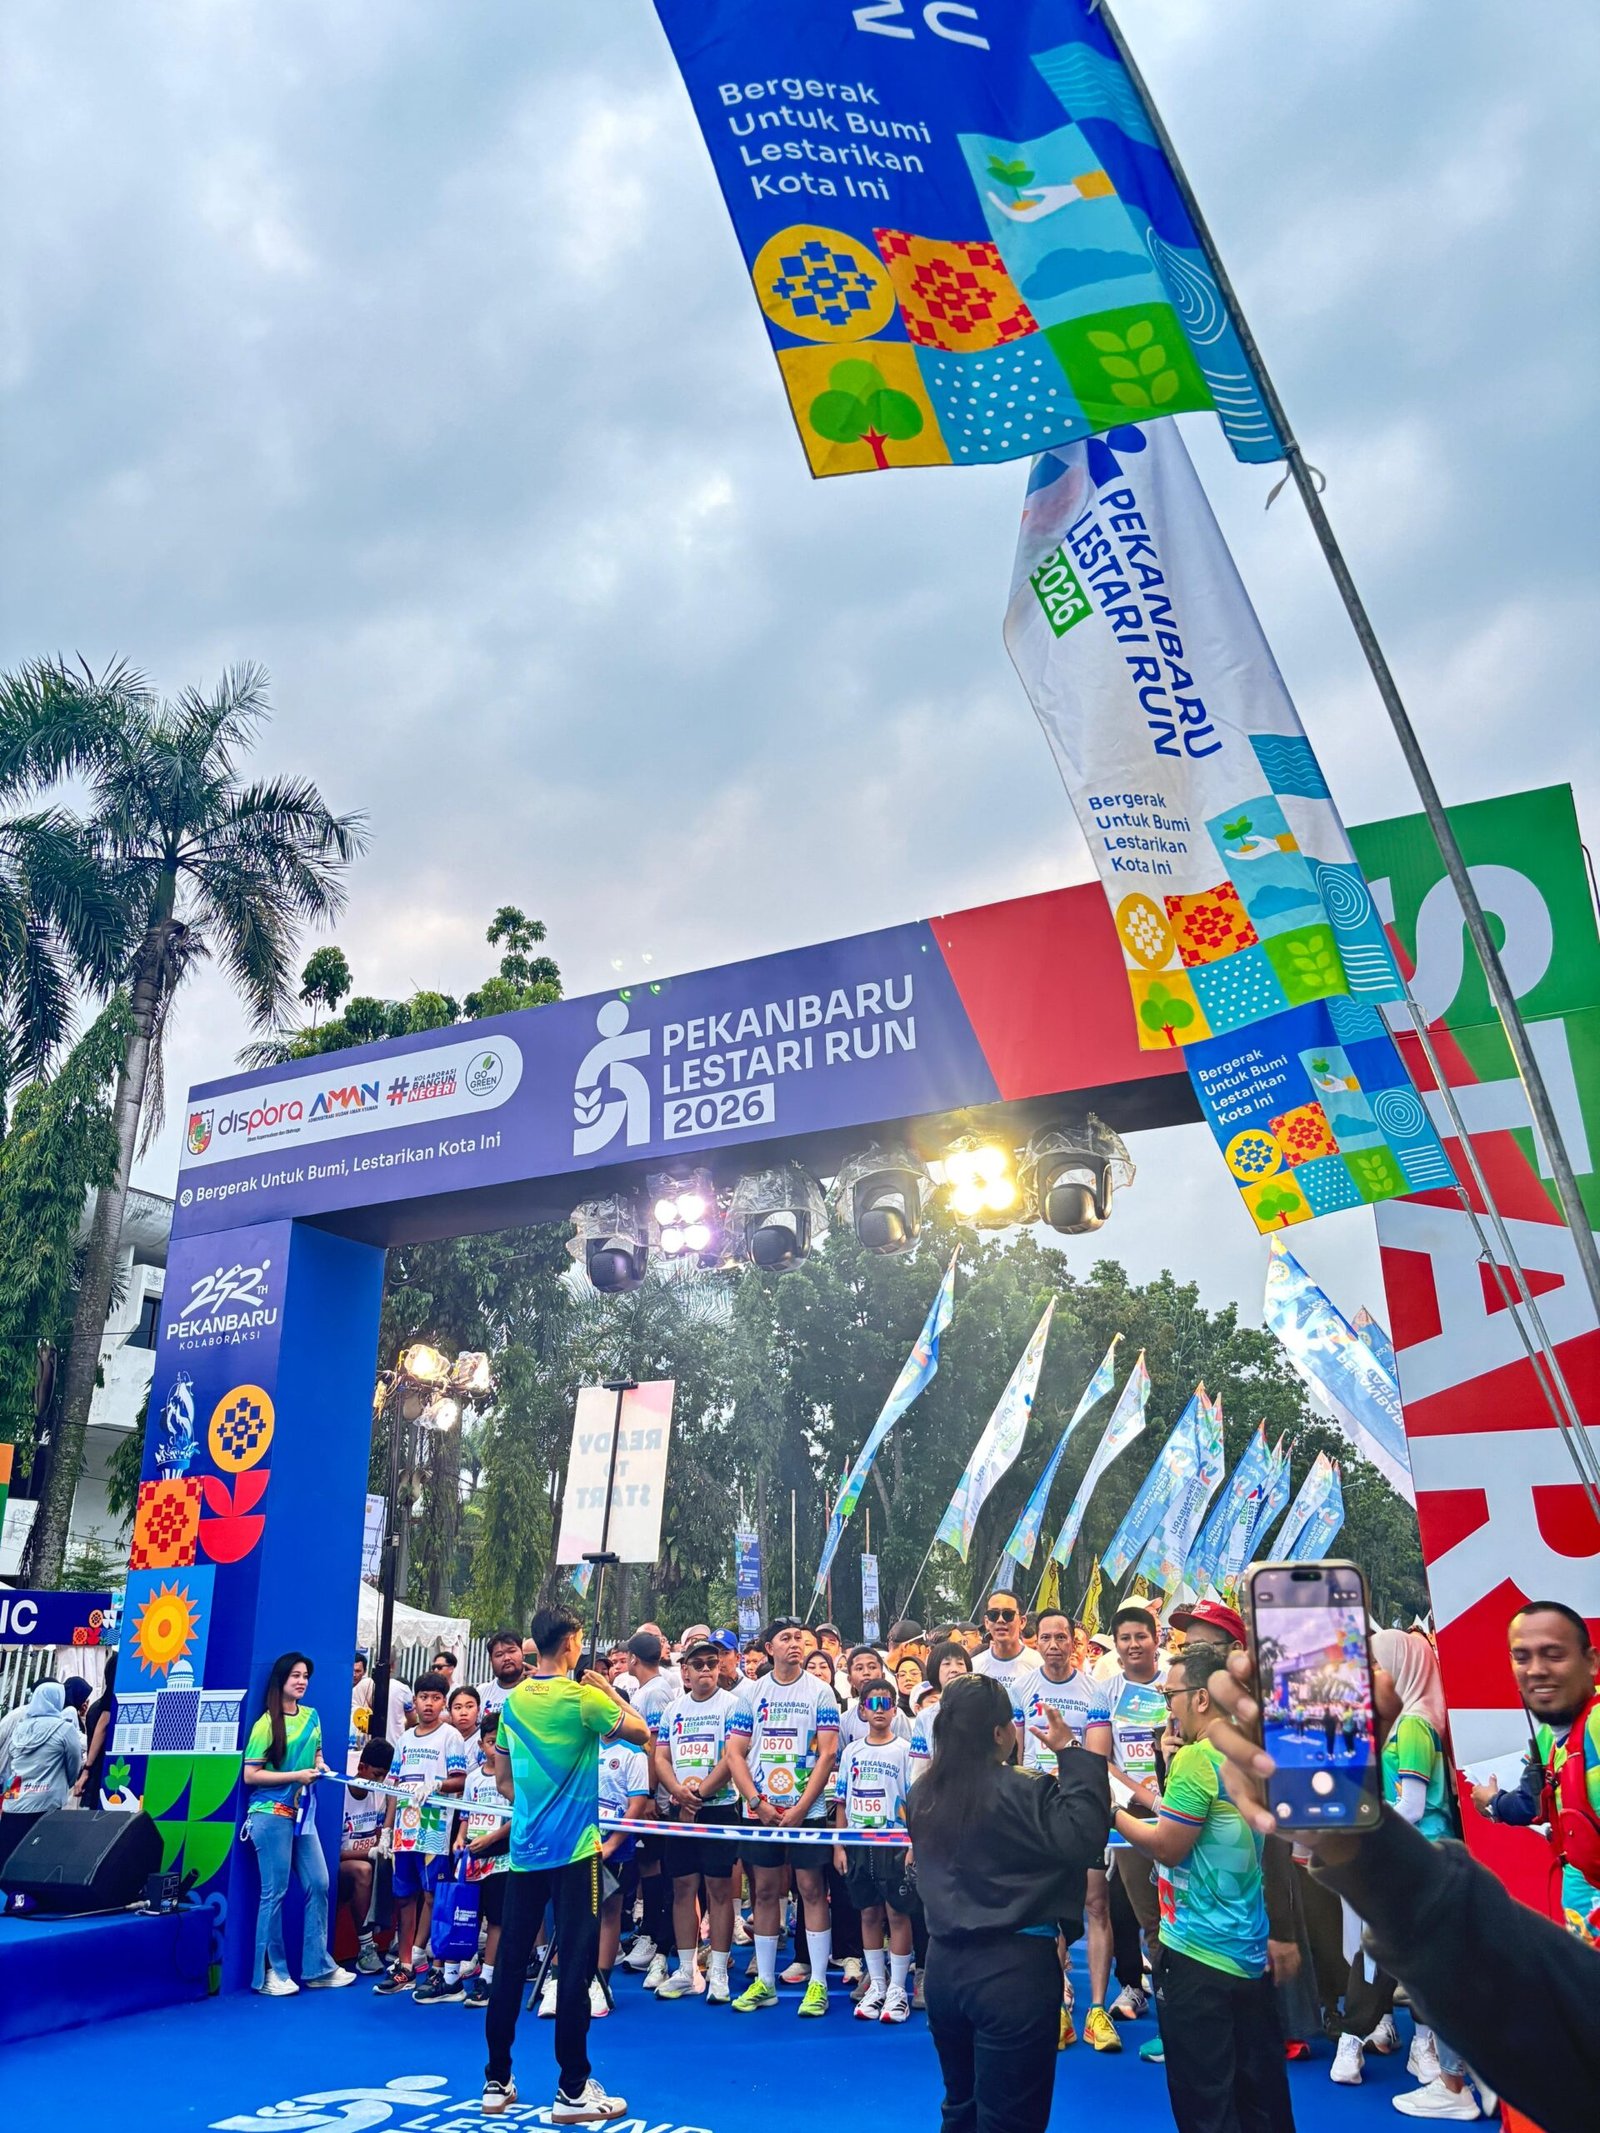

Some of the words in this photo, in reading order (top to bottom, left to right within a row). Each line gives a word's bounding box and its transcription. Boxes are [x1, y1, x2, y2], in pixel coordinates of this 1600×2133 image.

[718, 76, 880, 107] Bergerak
[728, 107, 839, 137] Untuk
[848, 112, 932, 145] Bumi
[739, 140, 925, 174] Lestarikan
[751, 173, 838, 200] Kota
[845, 175, 891, 201] Ini
[1032, 552, 1085, 627] 2026
[1066, 510, 1150, 643] LESTARI
[1125, 657, 1182, 758] RUN
[1099, 488, 1223, 759] PEKANBARU
[1088, 793, 1167, 811] Bergerak
[1096, 812, 1150, 830] Untuk
[1154, 813, 1191, 832] Bumi
[1104, 835, 1188, 854] Lestarikan
[1111, 856, 1150, 874] Kota
[1152, 859, 1172, 875] Ini
[663, 974, 913, 1056] PEKANBARU
[663, 1037, 813, 1095] LESTARI
[825, 1017, 916, 1066] RUN
[1198, 1049, 1264, 1082] Bergerak
[412, 1074, 456, 1090] BANGUN
[414, 1068, 457, 1082] KOLABORASI
[470, 1076, 497, 1089] GREEN
[474, 1070, 488, 1080] GO
[1204, 1071, 1249, 1097] Untuk
[1250, 1054, 1288, 1076] Bumi
[309, 1081, 380, 1117] AMAN
[409, 1082, 456, 1101] NEGERI
[1210, 1072, 1286, 1112] Lestarikan
[218, 1099, 304, 1136] dispora
[673, 1090, 765, 1134] 2026
[1217, 1105, 1253, 1126] Kota
[1254, 1093, 1274, 1111] Ini
[196, 1176, 258, 1203] Bergerak
[261, 1168, 304, 1189] Untuk
[307, 1159, 351, 1181] Bumi,
[353, 1143, 434, 1173] Lestarikan
[438, 1135, 476, 1157] Kota
[481, 1131, 501, 1150] Ini
[256, 1284, 268, 1296] TH
[166, 1308, 277, 1340] PEKANBARU
[1366, 864, 1600, 1770] STAR
[180, 1330, 261, 1351] KOLABORAKSI
[680, 1743, 709, 1756] 0494
[763, 1738, 793, 1751] 0670
[1127, 1742, 1155, 1758] 063
[352, 1811, 377, 1821] PEKANBAR
[853, 1798, 881, 1812] 0156
